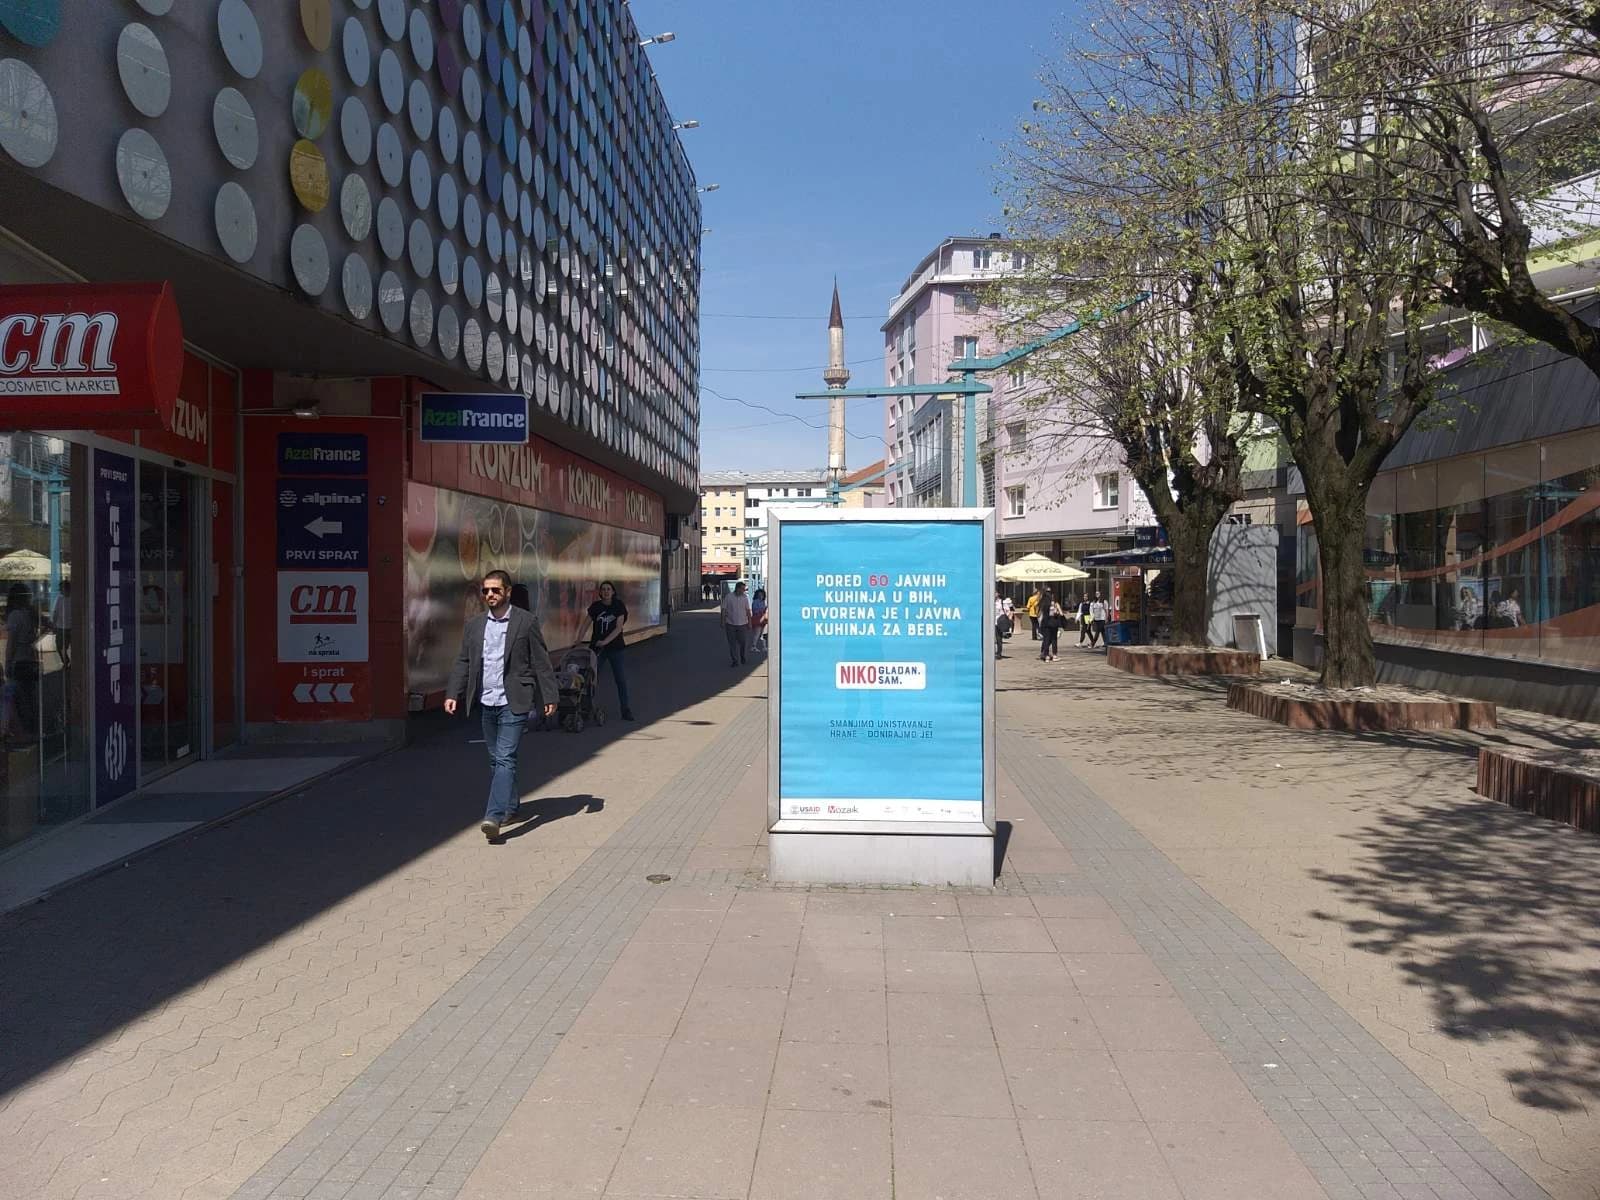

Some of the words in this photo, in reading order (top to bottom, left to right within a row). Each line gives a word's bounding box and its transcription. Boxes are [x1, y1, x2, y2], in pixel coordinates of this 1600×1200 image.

[0, 312, 118, 374] cm
[0, 380, 62, 393] COSMETIC
[66, 379, 117, 392] MARKET
[470, 443, 543, 493] KONZUM
[567, 463, 611, 512] KONZUM
[302, 492, 362, 506] alpina
[286, 550, 316, 560] PRVI
[318, 550, 359, 560] SPRAT
[816, 574, 862, 587] PORED
[869, 574, 889, 587] 60
[895, 574, 946, 587] JAVNIH
[290, 584, 357, 613] cm
[825, 591, 886, 603] KUHINJA
[893, 591, 902, 603] U
[909, 591, 938, 604] BIH,
[801, 607, 875, 619] OTVORENA
[882, 607, 898, 619] JE
[905, 607, 909, 619] I
[915, 607, 961, 619] JAVNA
[815, 623, 876, 636] KUHINJA
[883, 623, 901, 636] ZA
[908, 623, 948, 636] BEBE.
[311, 667, 345, 679] sprat
[840, 665, 877, 684] NIKO
[878, 666, 921, 675] GLADAN.
[878, 675, 903, 684] SAM.
[830, 719, 874, 728] SMANJIMO
[830, 730, 857, 738] HRANE
[867, 730, 917, 739] DONIRAJMO
